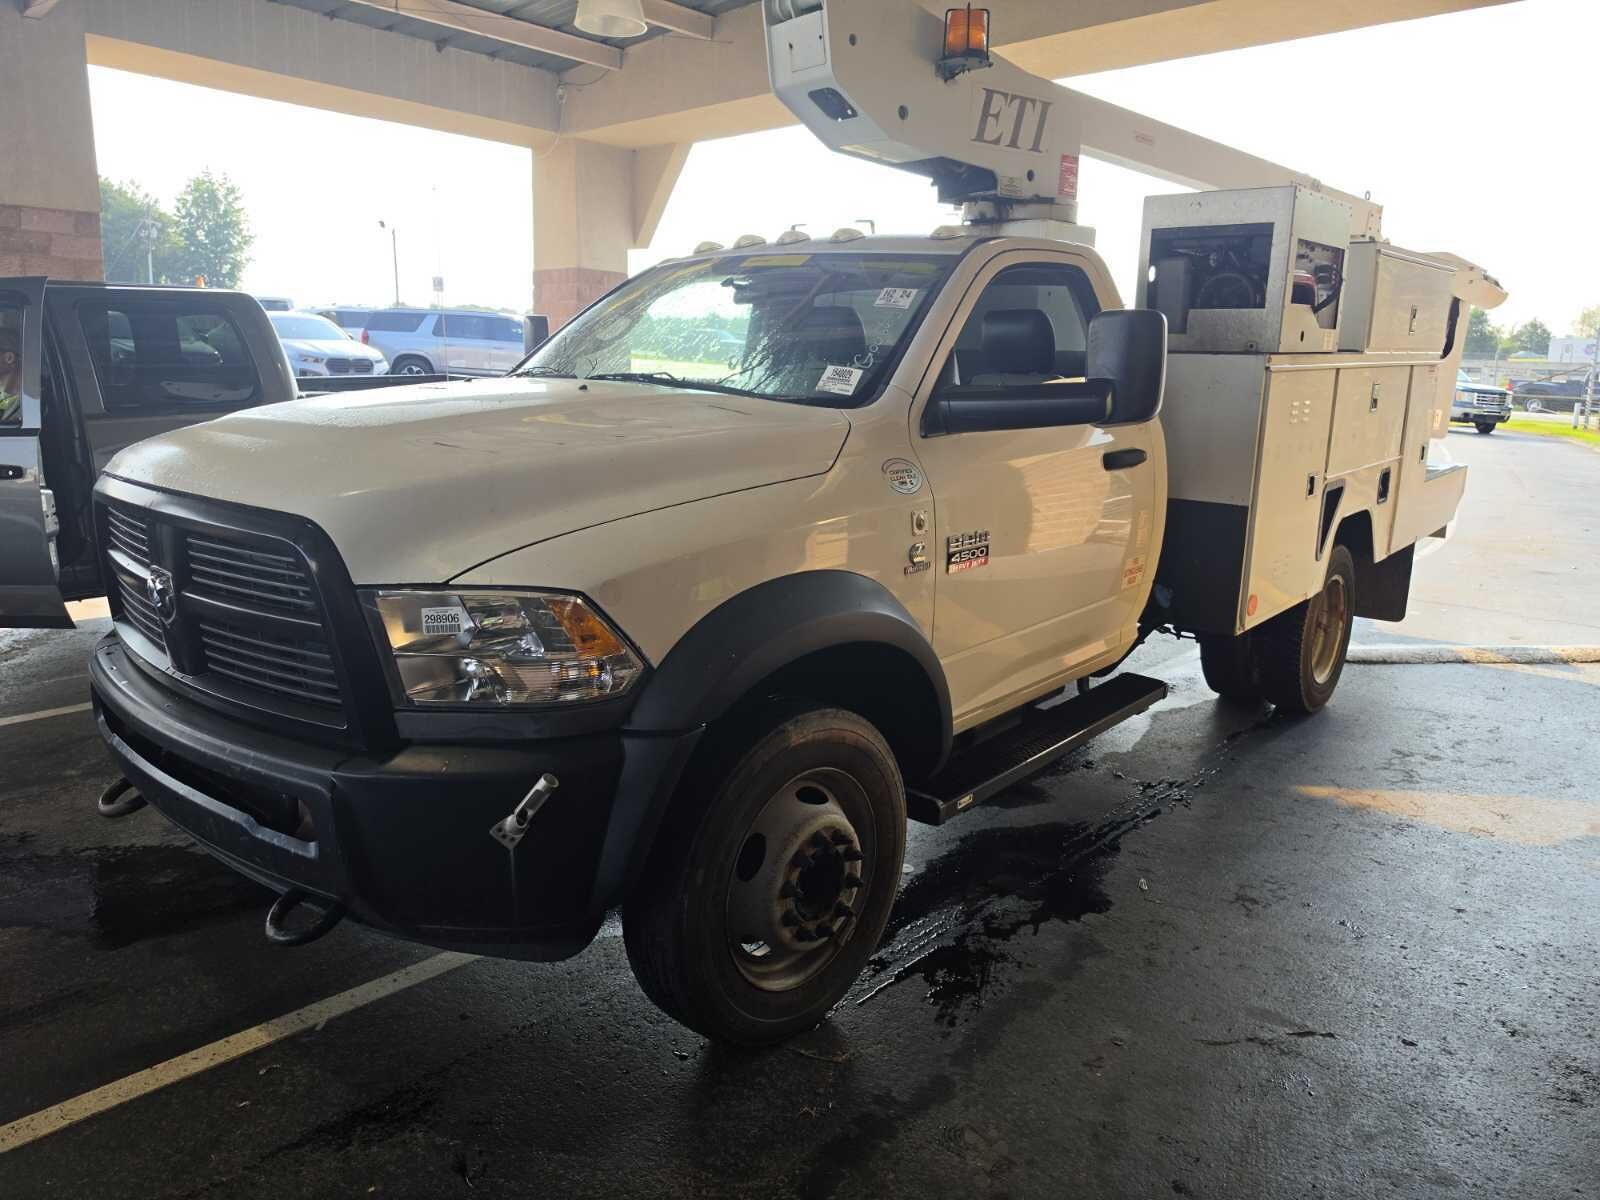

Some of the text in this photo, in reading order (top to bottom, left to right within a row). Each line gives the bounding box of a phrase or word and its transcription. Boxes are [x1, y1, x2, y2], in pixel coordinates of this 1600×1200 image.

[970, 87, 1054, 153] ETI
[951, 547, 987, 563] 4500
[424, 613, 460, 624] 298906
